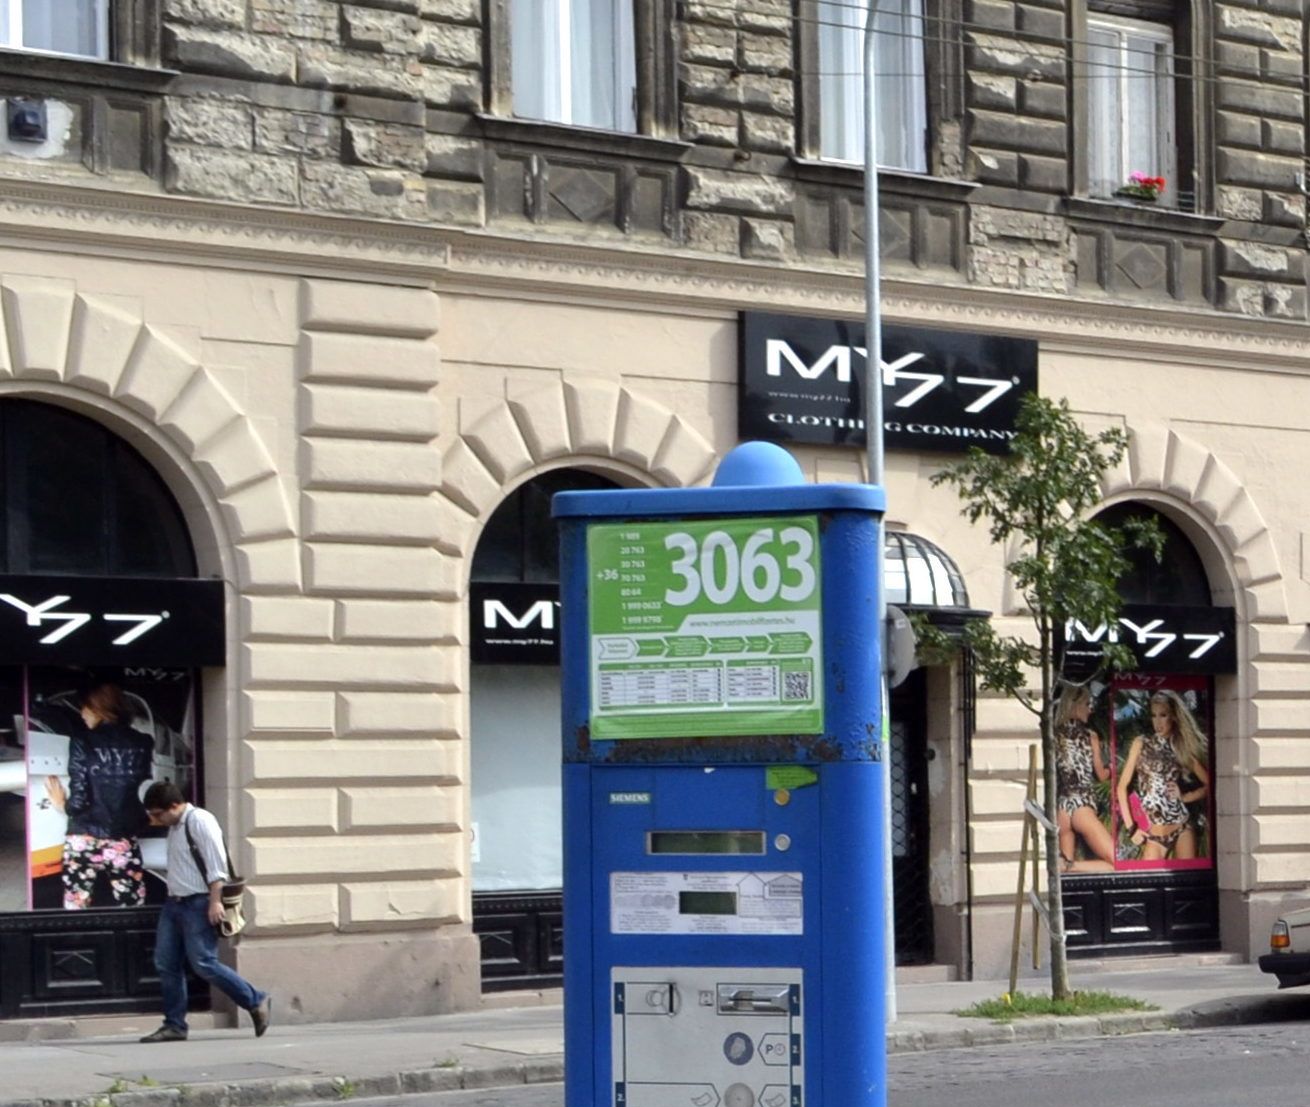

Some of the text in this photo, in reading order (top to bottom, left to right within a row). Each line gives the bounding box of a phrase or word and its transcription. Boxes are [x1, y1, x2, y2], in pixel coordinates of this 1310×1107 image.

[766, 339, 1013, 414] MY77
[767, 412, 1020, 441] CLOTHIG COMPANY
[596, 568, 619, 581] +36
[664, 526, 816, 606] 3063
[483, 599, 562, 629] M
[1065, 617, 1221, 659] MY77
[610, 793, 650, 801] SIEMENS
